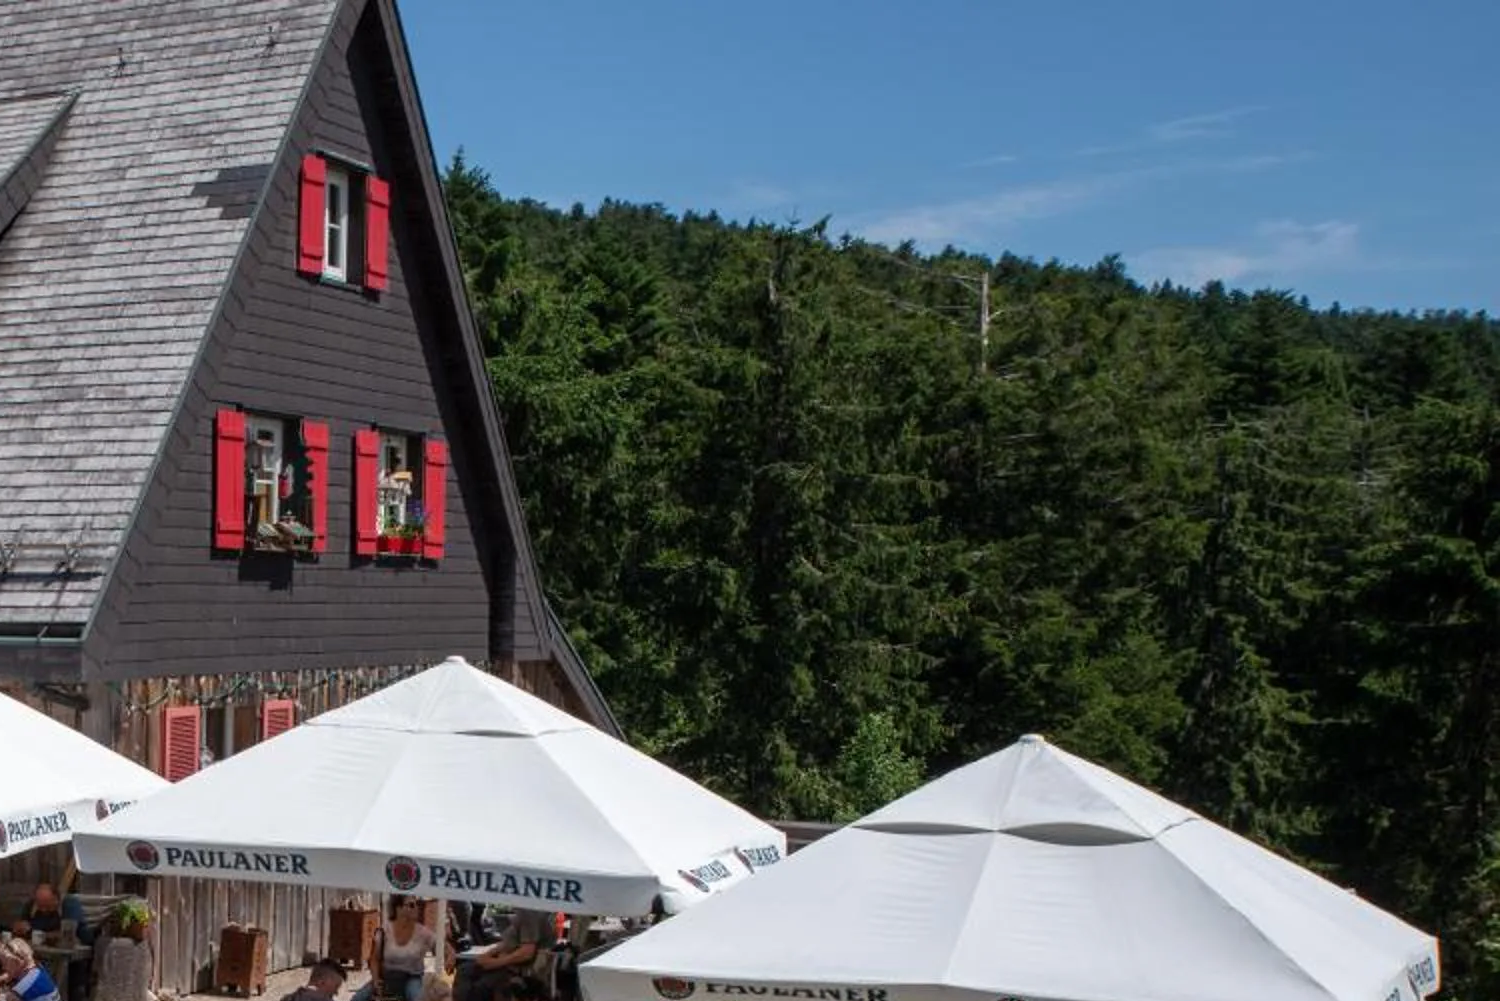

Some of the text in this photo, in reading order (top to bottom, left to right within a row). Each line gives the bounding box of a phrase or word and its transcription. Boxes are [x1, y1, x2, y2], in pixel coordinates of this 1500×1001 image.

[7, 811, 71, 843] PAULANER
[164, 847, 311, 875] PAULANER
[428, 864, 583, 902] PAULANER
